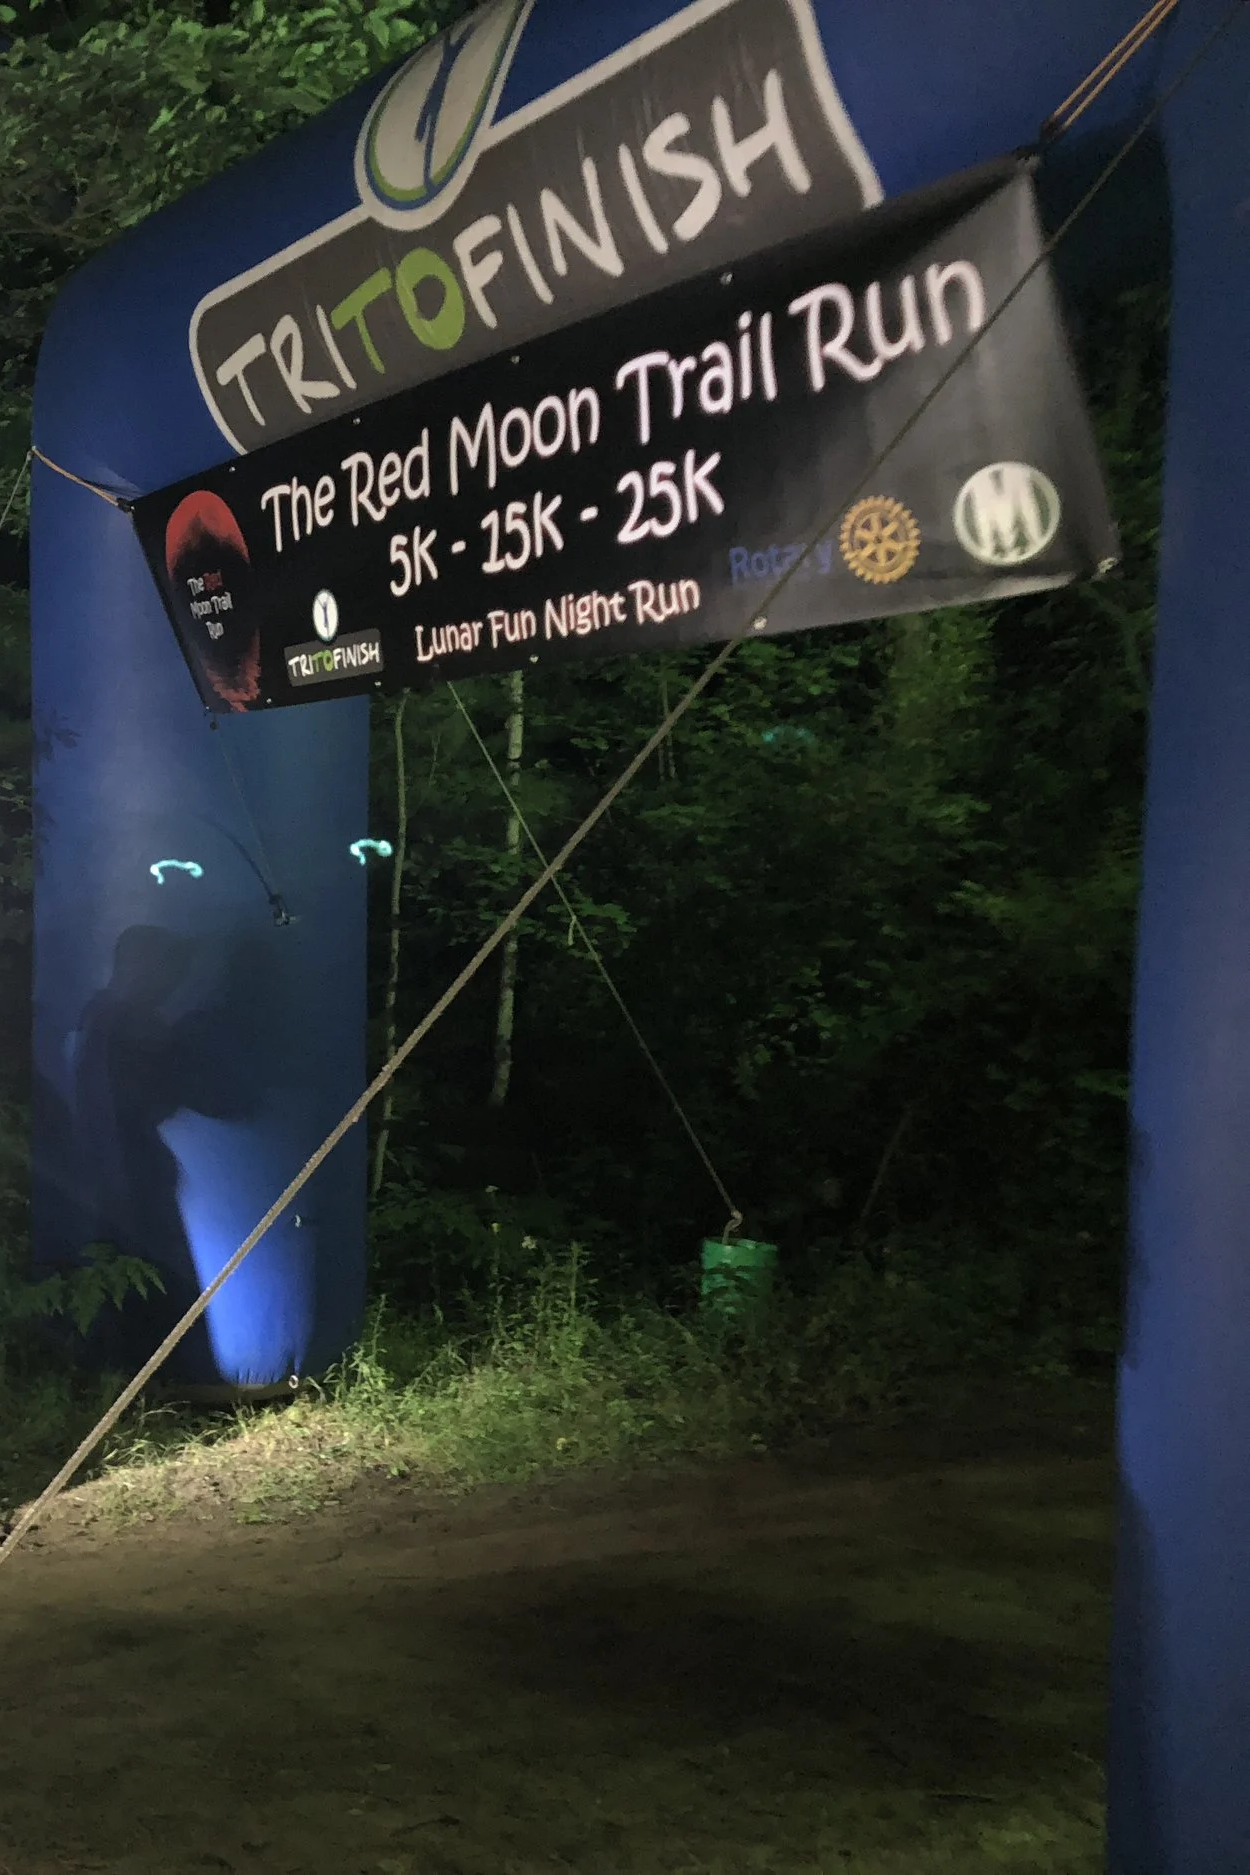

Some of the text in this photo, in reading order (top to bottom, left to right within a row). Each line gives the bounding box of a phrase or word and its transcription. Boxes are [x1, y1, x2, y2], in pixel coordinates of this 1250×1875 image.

[216, 70, 811, 428] TRITOFINISH
[261, 259, 986, 553] The Red Moon Trail Run
[389, 525, 438, 597] 5K
[480, 491, 565, 573] 15K
[616, 448, 726, 545] 25K
[187, 576, 205, 597] The
[414, 579, 701, 662] Lunar Fun Night Run
[288, 641, 381, 678] TRITOFINISH
